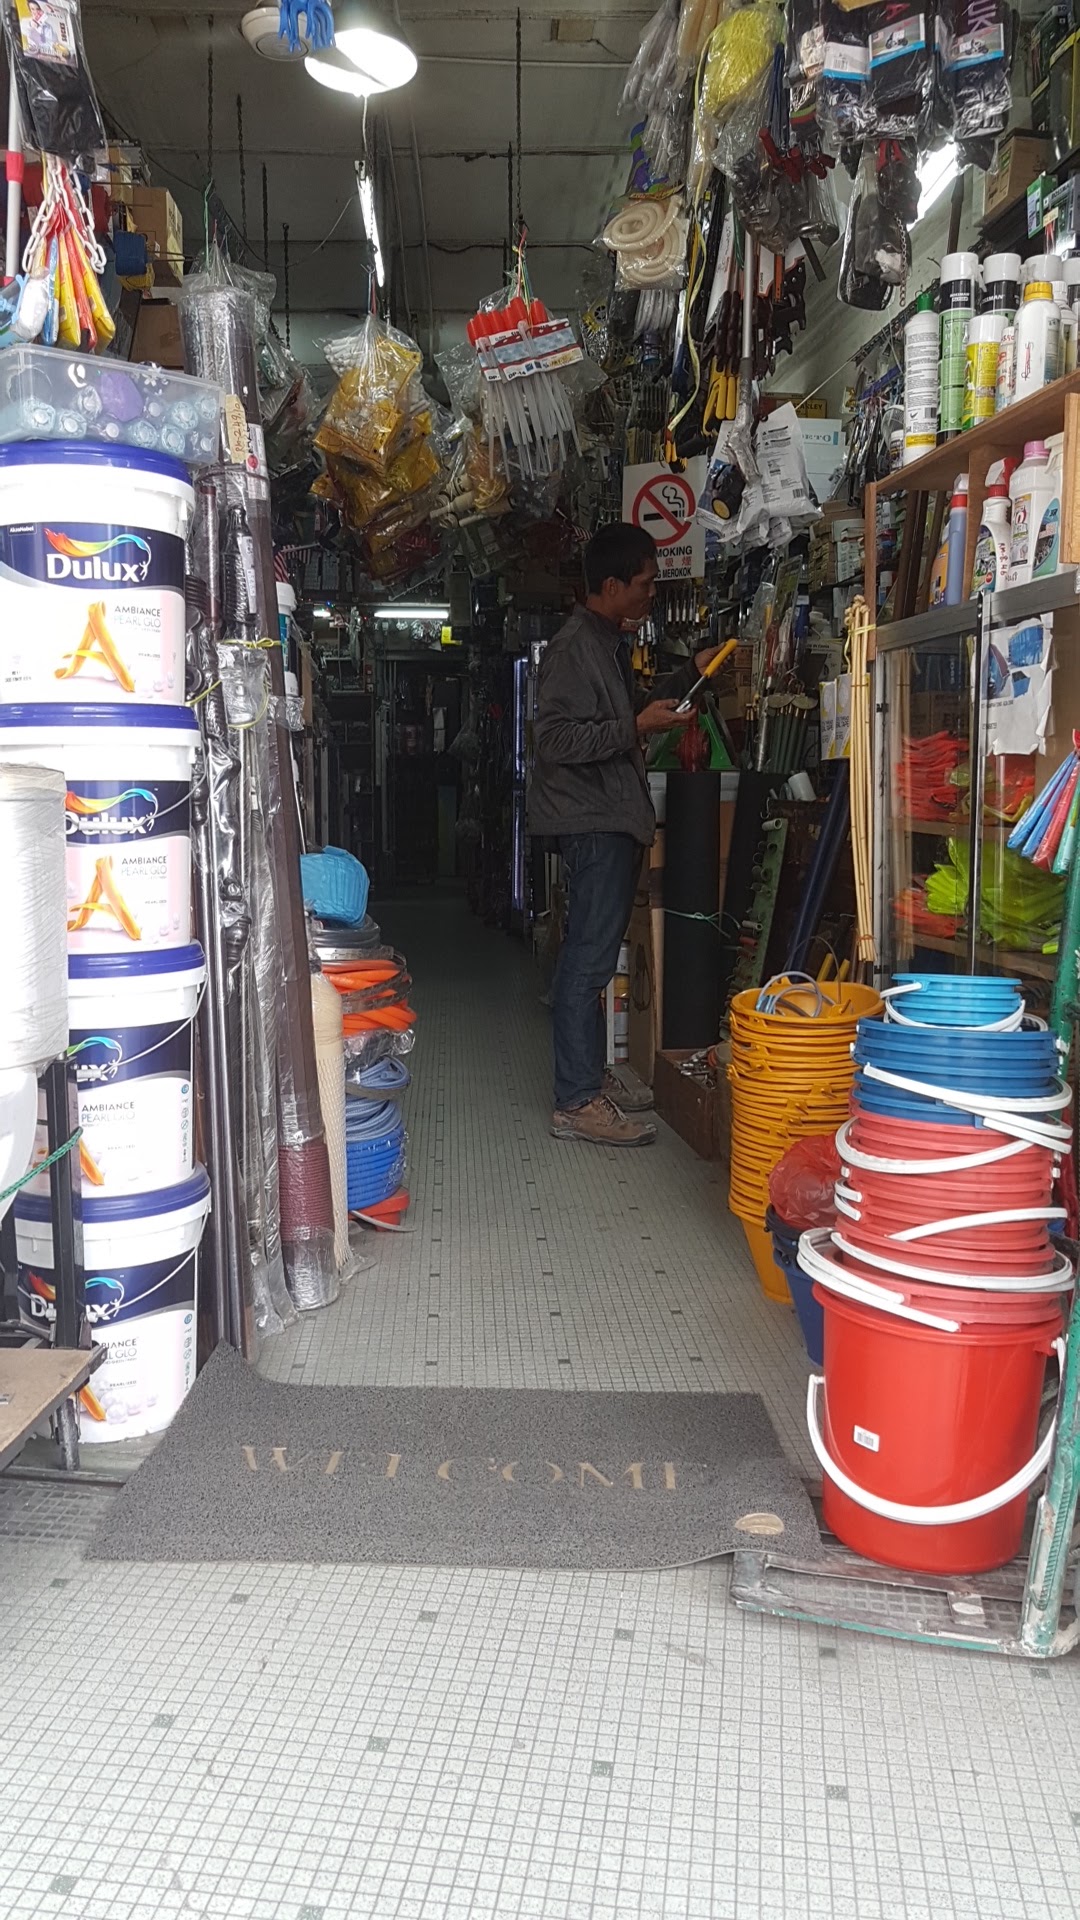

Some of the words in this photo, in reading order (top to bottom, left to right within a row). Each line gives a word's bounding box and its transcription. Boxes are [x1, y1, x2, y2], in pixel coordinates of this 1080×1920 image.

[656, 546, 693, 558] MOKING
[46, 553, 140, 583] Dulux
[663, 567, 692, 578] MEROKOK
[114, 605, 161, 617] AMBIANCE
[114, 615, 141, 626] PEARL
[144, 617, 161, 628] GLO
[121, 855, 167, 865] AMBIANCE
[121, 866, 148, 877] PEARL
[150, 865, 168, 875] GLO
[81, 1101, 135, 1112] AMBIANCE
[81, 1112, 111, 1123] PEARL
[101, 1338, 137, 1350] BIANCE
[115, 1347, 138, 1359] GLO
